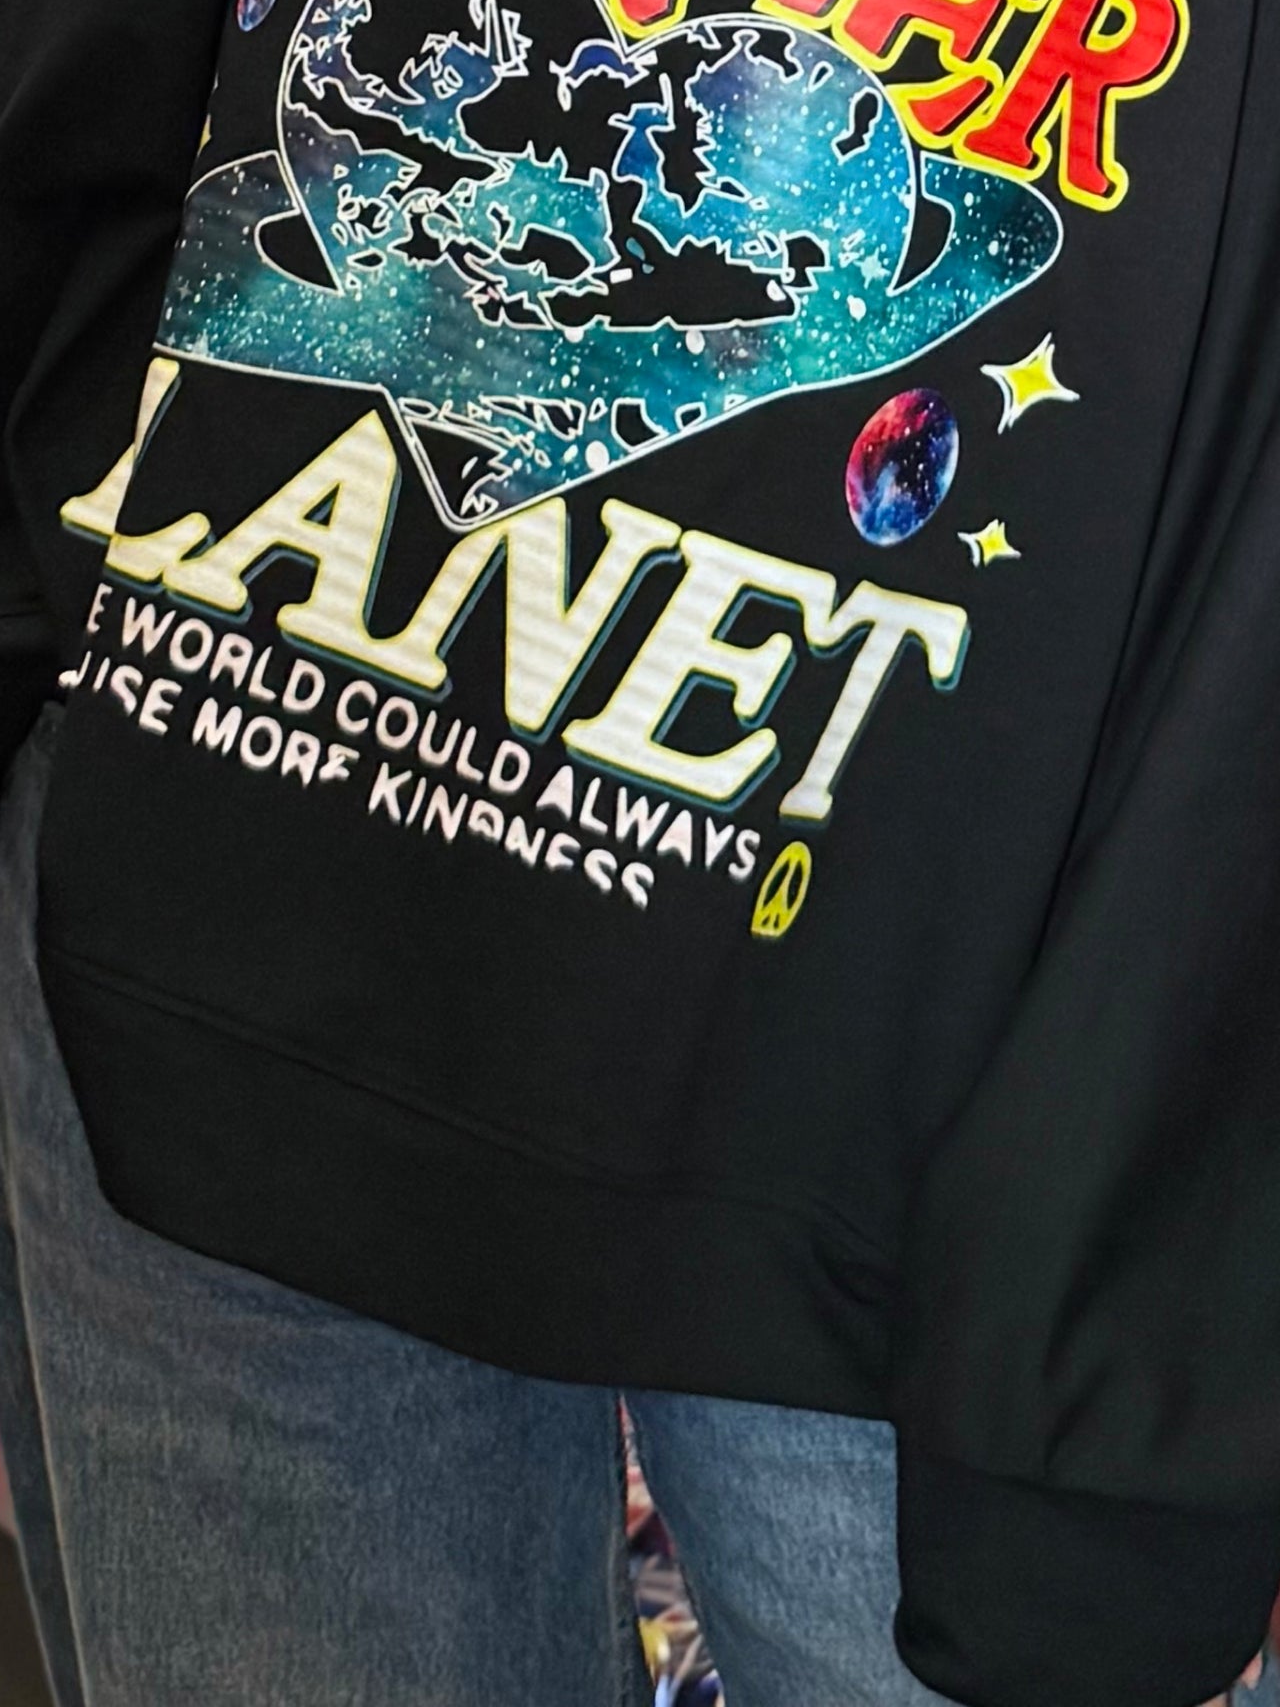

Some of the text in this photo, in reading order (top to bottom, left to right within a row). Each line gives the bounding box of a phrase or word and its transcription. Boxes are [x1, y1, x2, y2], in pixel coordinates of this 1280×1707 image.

[121, 596, 326, 713] WORLD
[335, 680, 532, 795] COULD
[536, 764, 762, 881] ALWAYS
[191, 696, 361, 788] MORE
